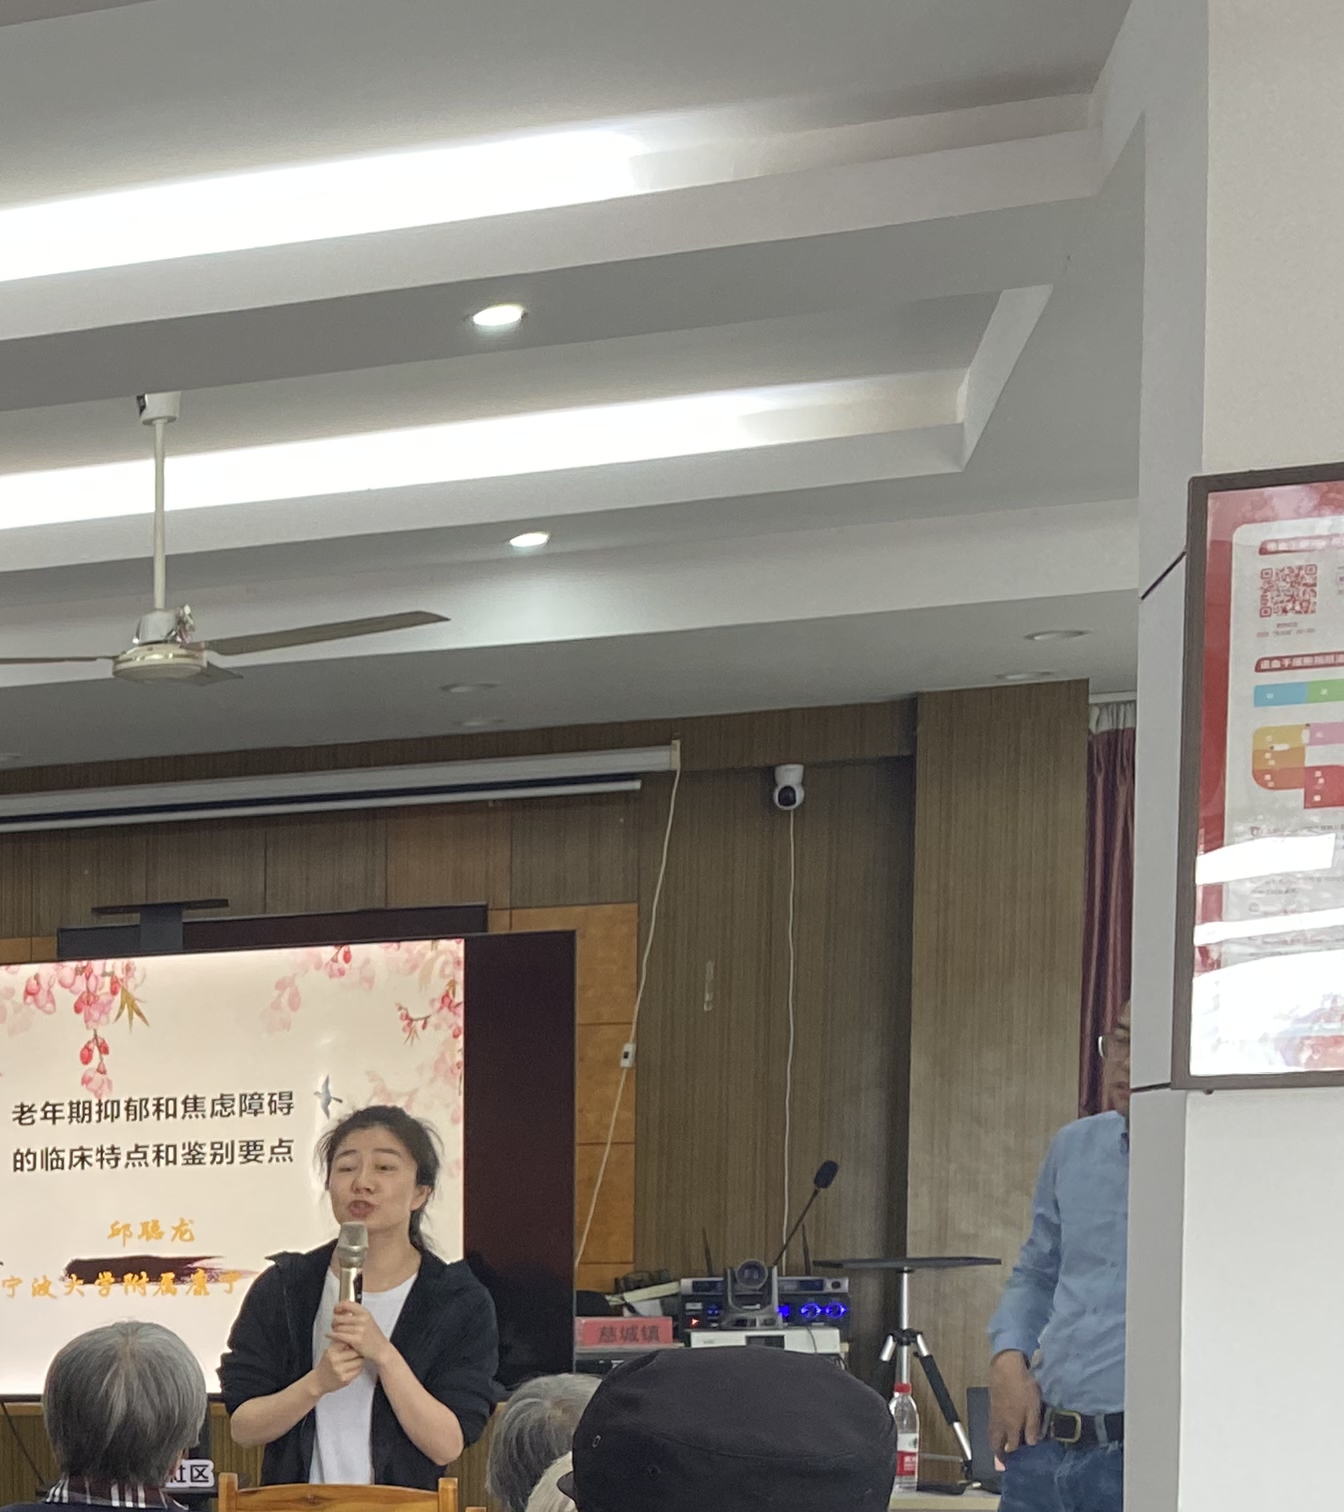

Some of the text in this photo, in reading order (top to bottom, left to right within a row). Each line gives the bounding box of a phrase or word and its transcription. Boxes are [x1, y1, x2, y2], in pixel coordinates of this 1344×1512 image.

[11, 1091, 295, 1127] 老年期抑郁和焦虑障碍
[12, 1138, 295, 1172] 的临床特点和鉴别要点
[108, 1218, 196, 1247] 邱聪龙
